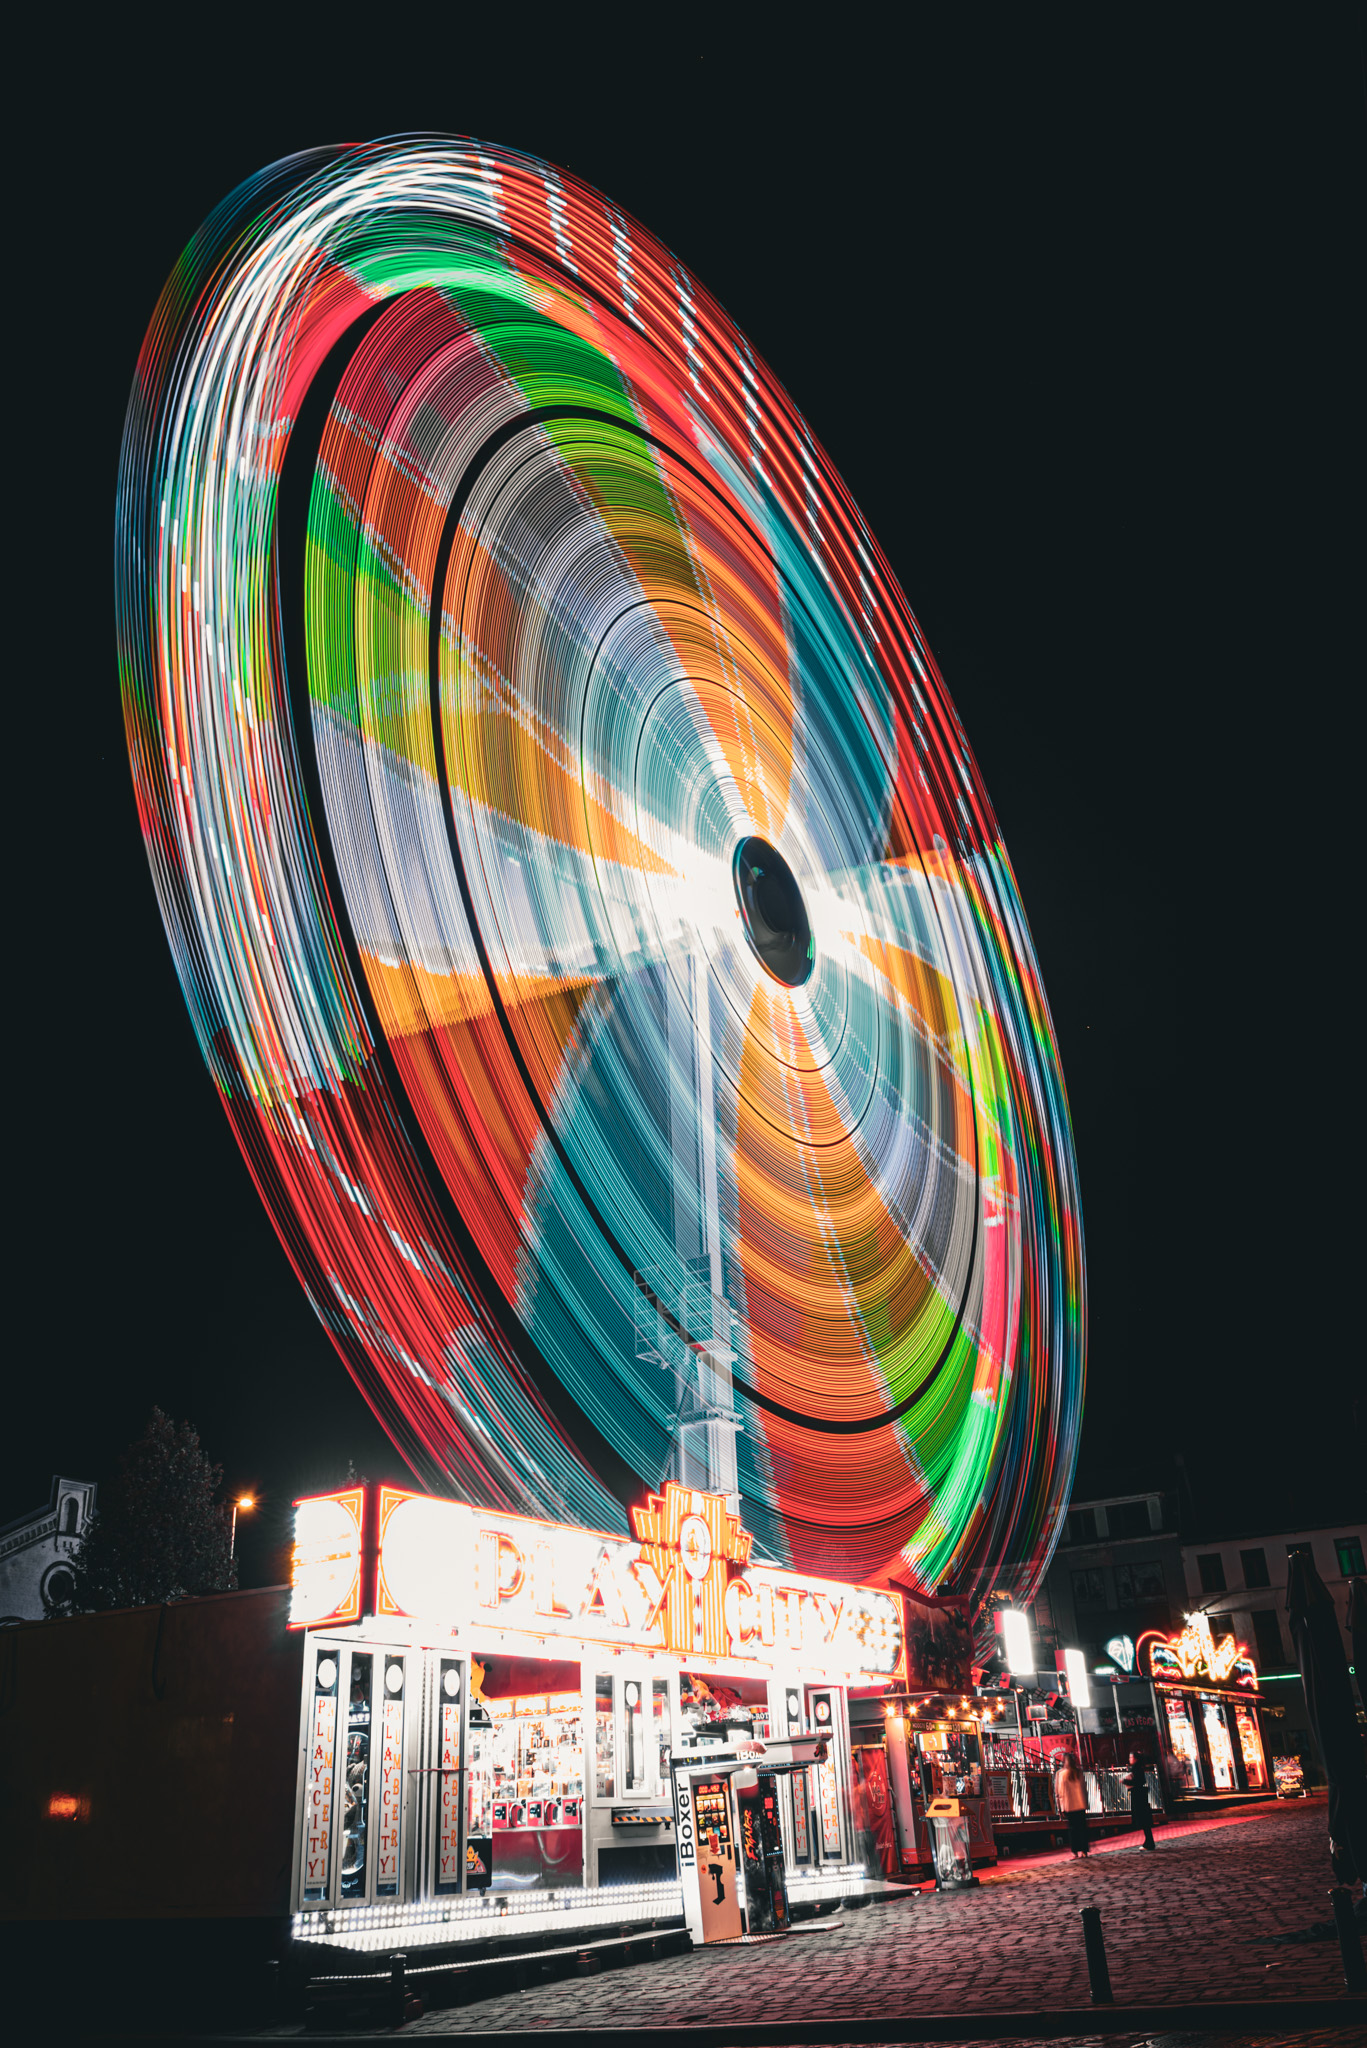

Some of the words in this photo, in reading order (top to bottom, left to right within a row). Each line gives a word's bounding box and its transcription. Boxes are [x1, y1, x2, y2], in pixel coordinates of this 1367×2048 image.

[478, 1528, 674, 1632] PLAY
[725, 1577, 844, 1650] CITY
[819, 1705, 825, 1716] 1
[677, 1783, 695, 1867] iBoxer
